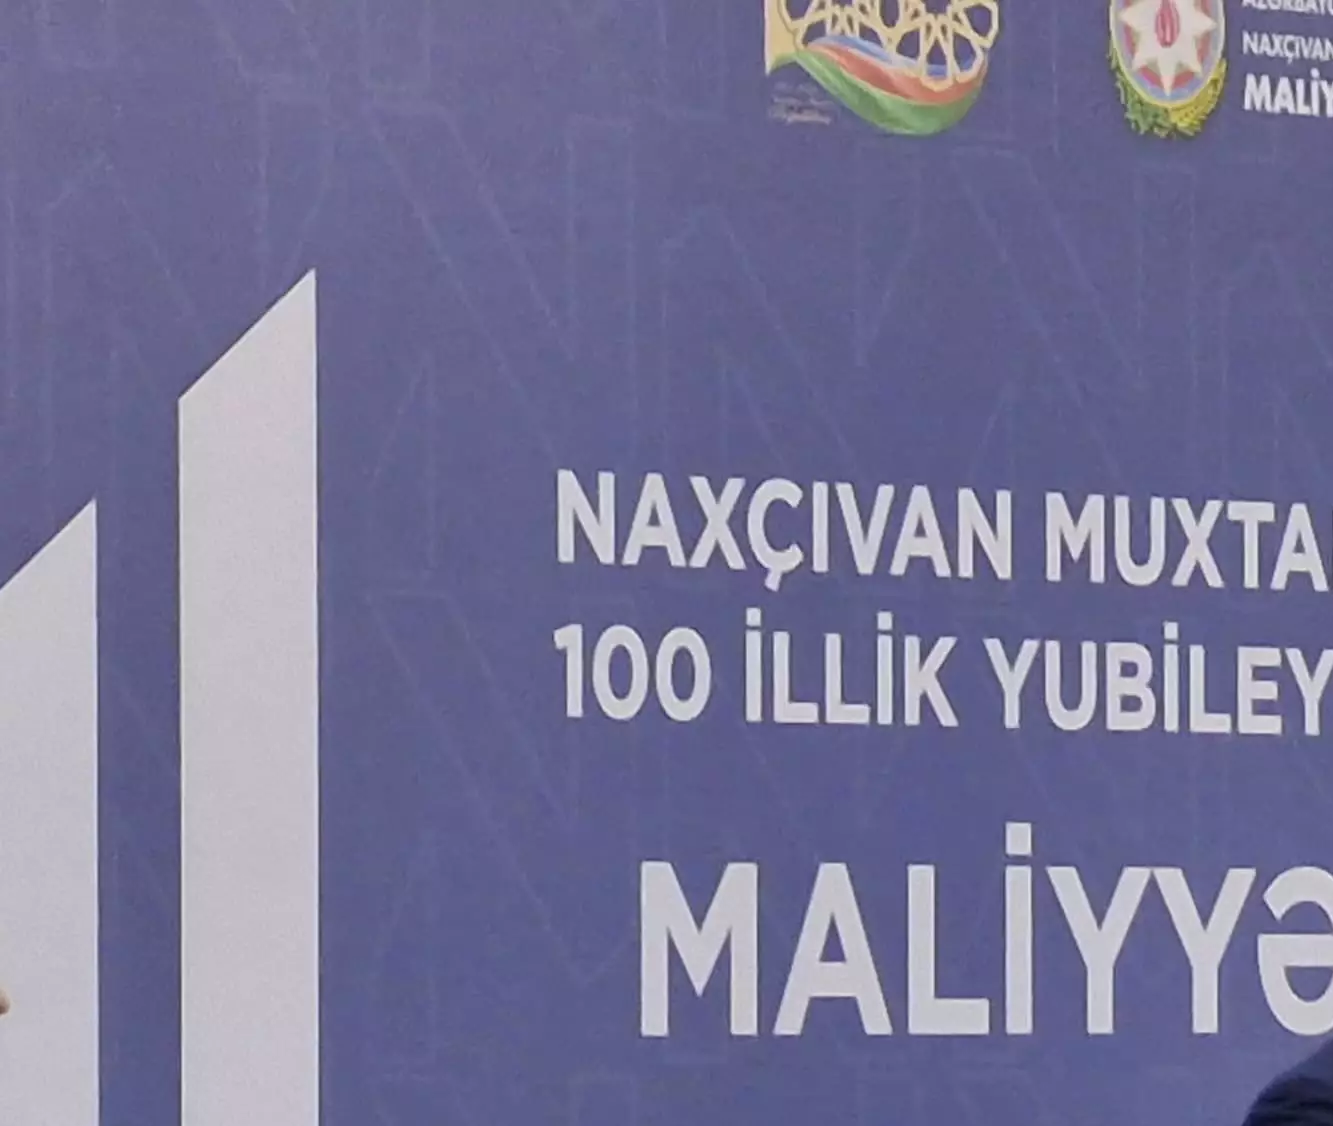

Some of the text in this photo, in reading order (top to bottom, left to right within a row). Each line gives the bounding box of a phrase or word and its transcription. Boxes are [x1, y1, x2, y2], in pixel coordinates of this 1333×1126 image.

[557, 469, 1012, 592] NAXÇIVAN
[553, 623, 712, 722] 100
[745, 607, 959, 727] İLLİK
